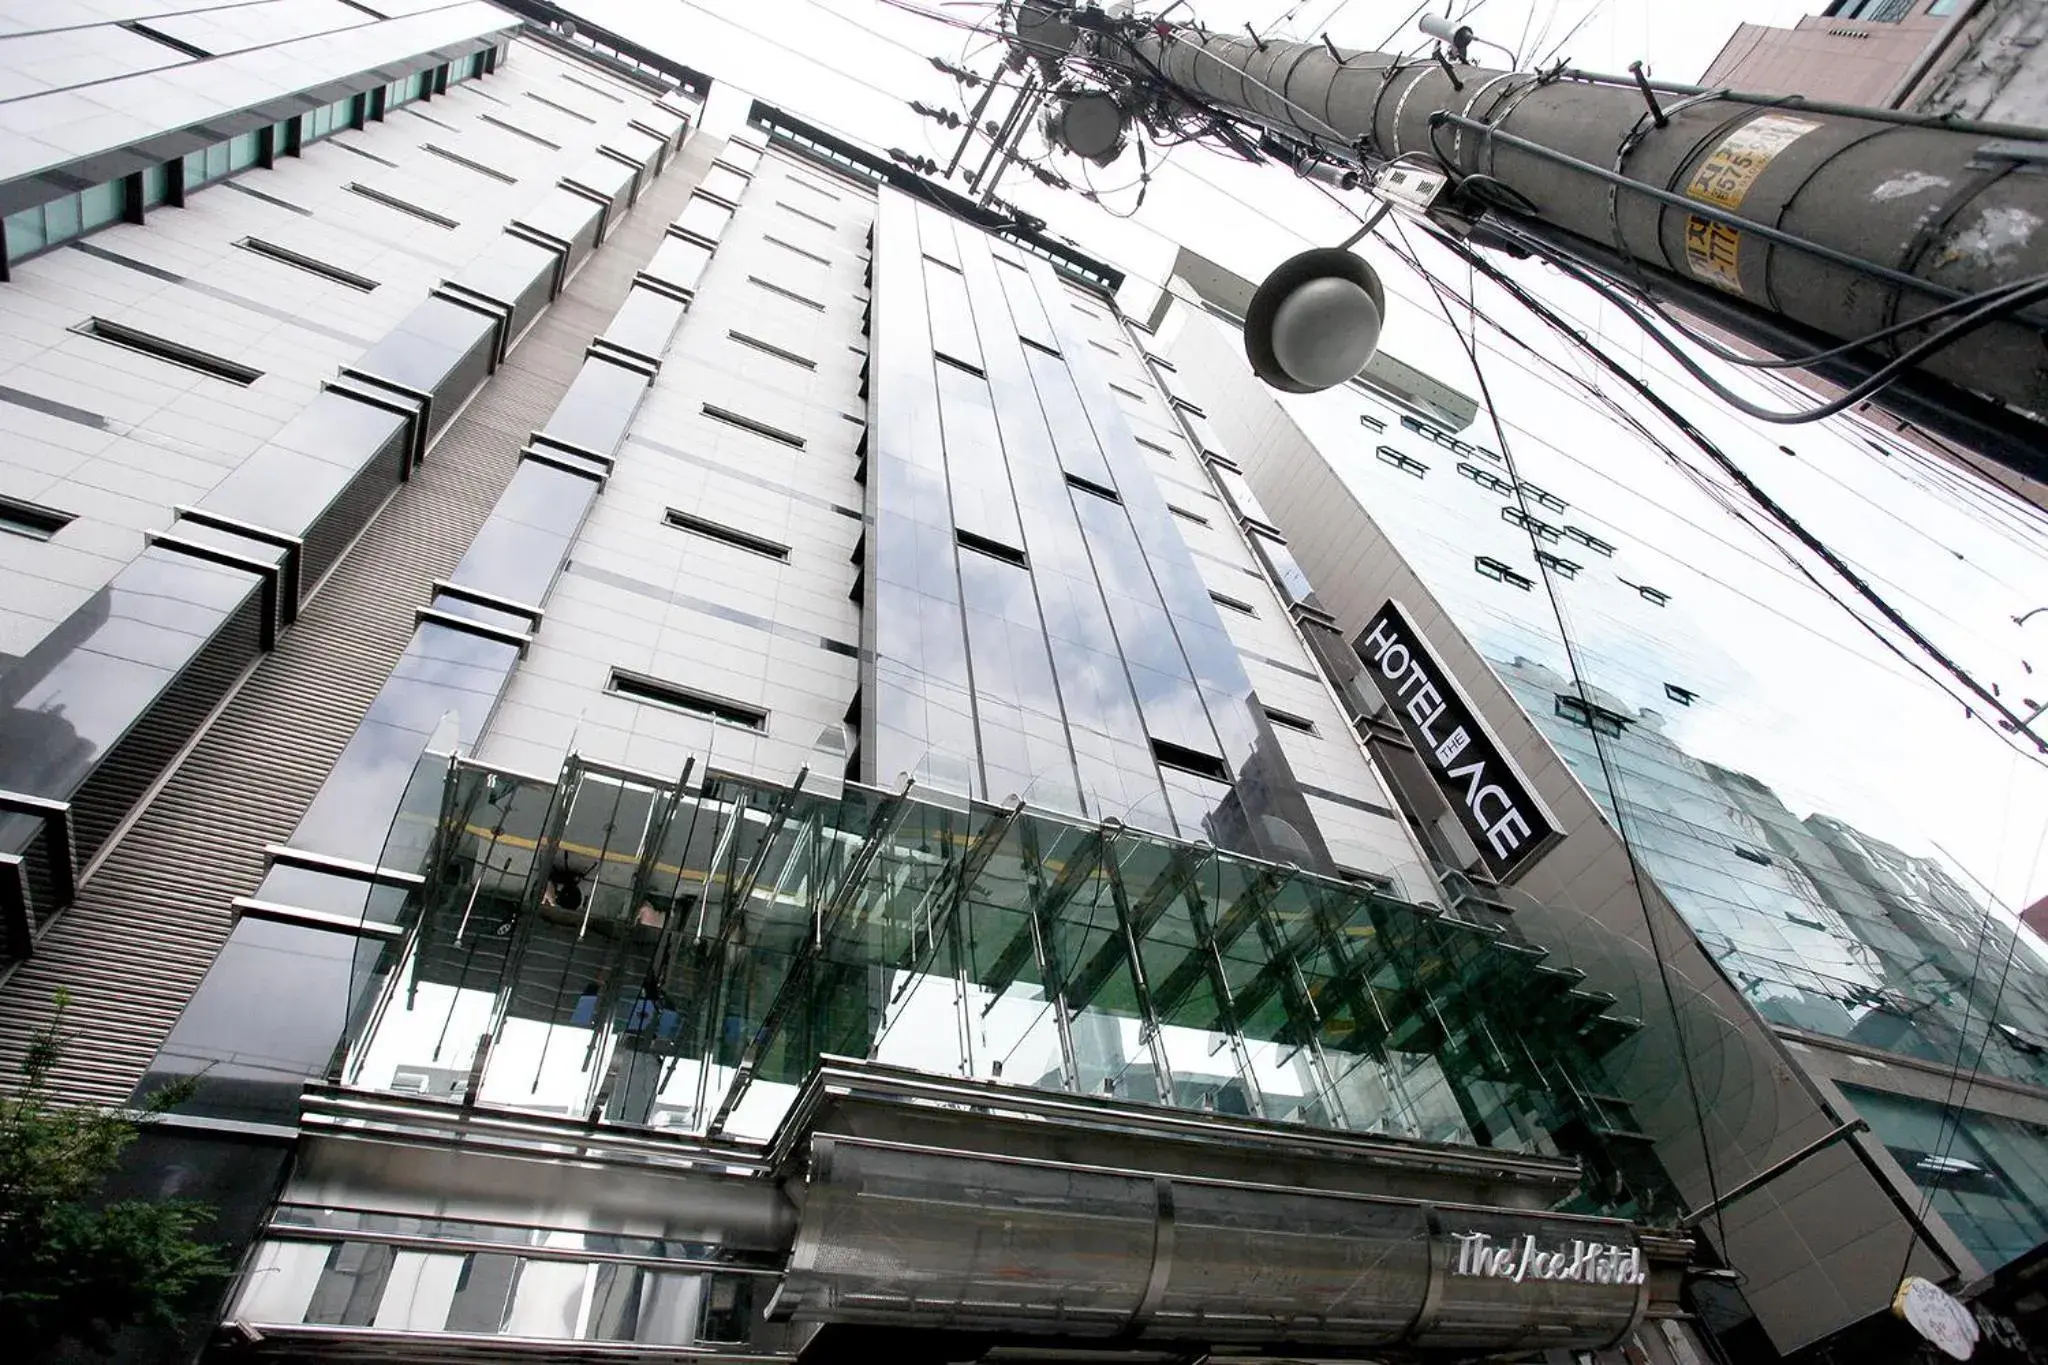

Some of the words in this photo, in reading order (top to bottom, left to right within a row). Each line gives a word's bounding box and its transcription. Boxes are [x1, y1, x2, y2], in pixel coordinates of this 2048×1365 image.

[1365, 620, 1447, 747] HOTEL
[1440, 734, 1467, 759] THE
[1448, 761, 1532, 859] ACE
[1451, 1230, 1515, 1277] The
[1514, 1234, 1569, 1284] Ace
[1568, 1239, 1645, 1285] Hotel
